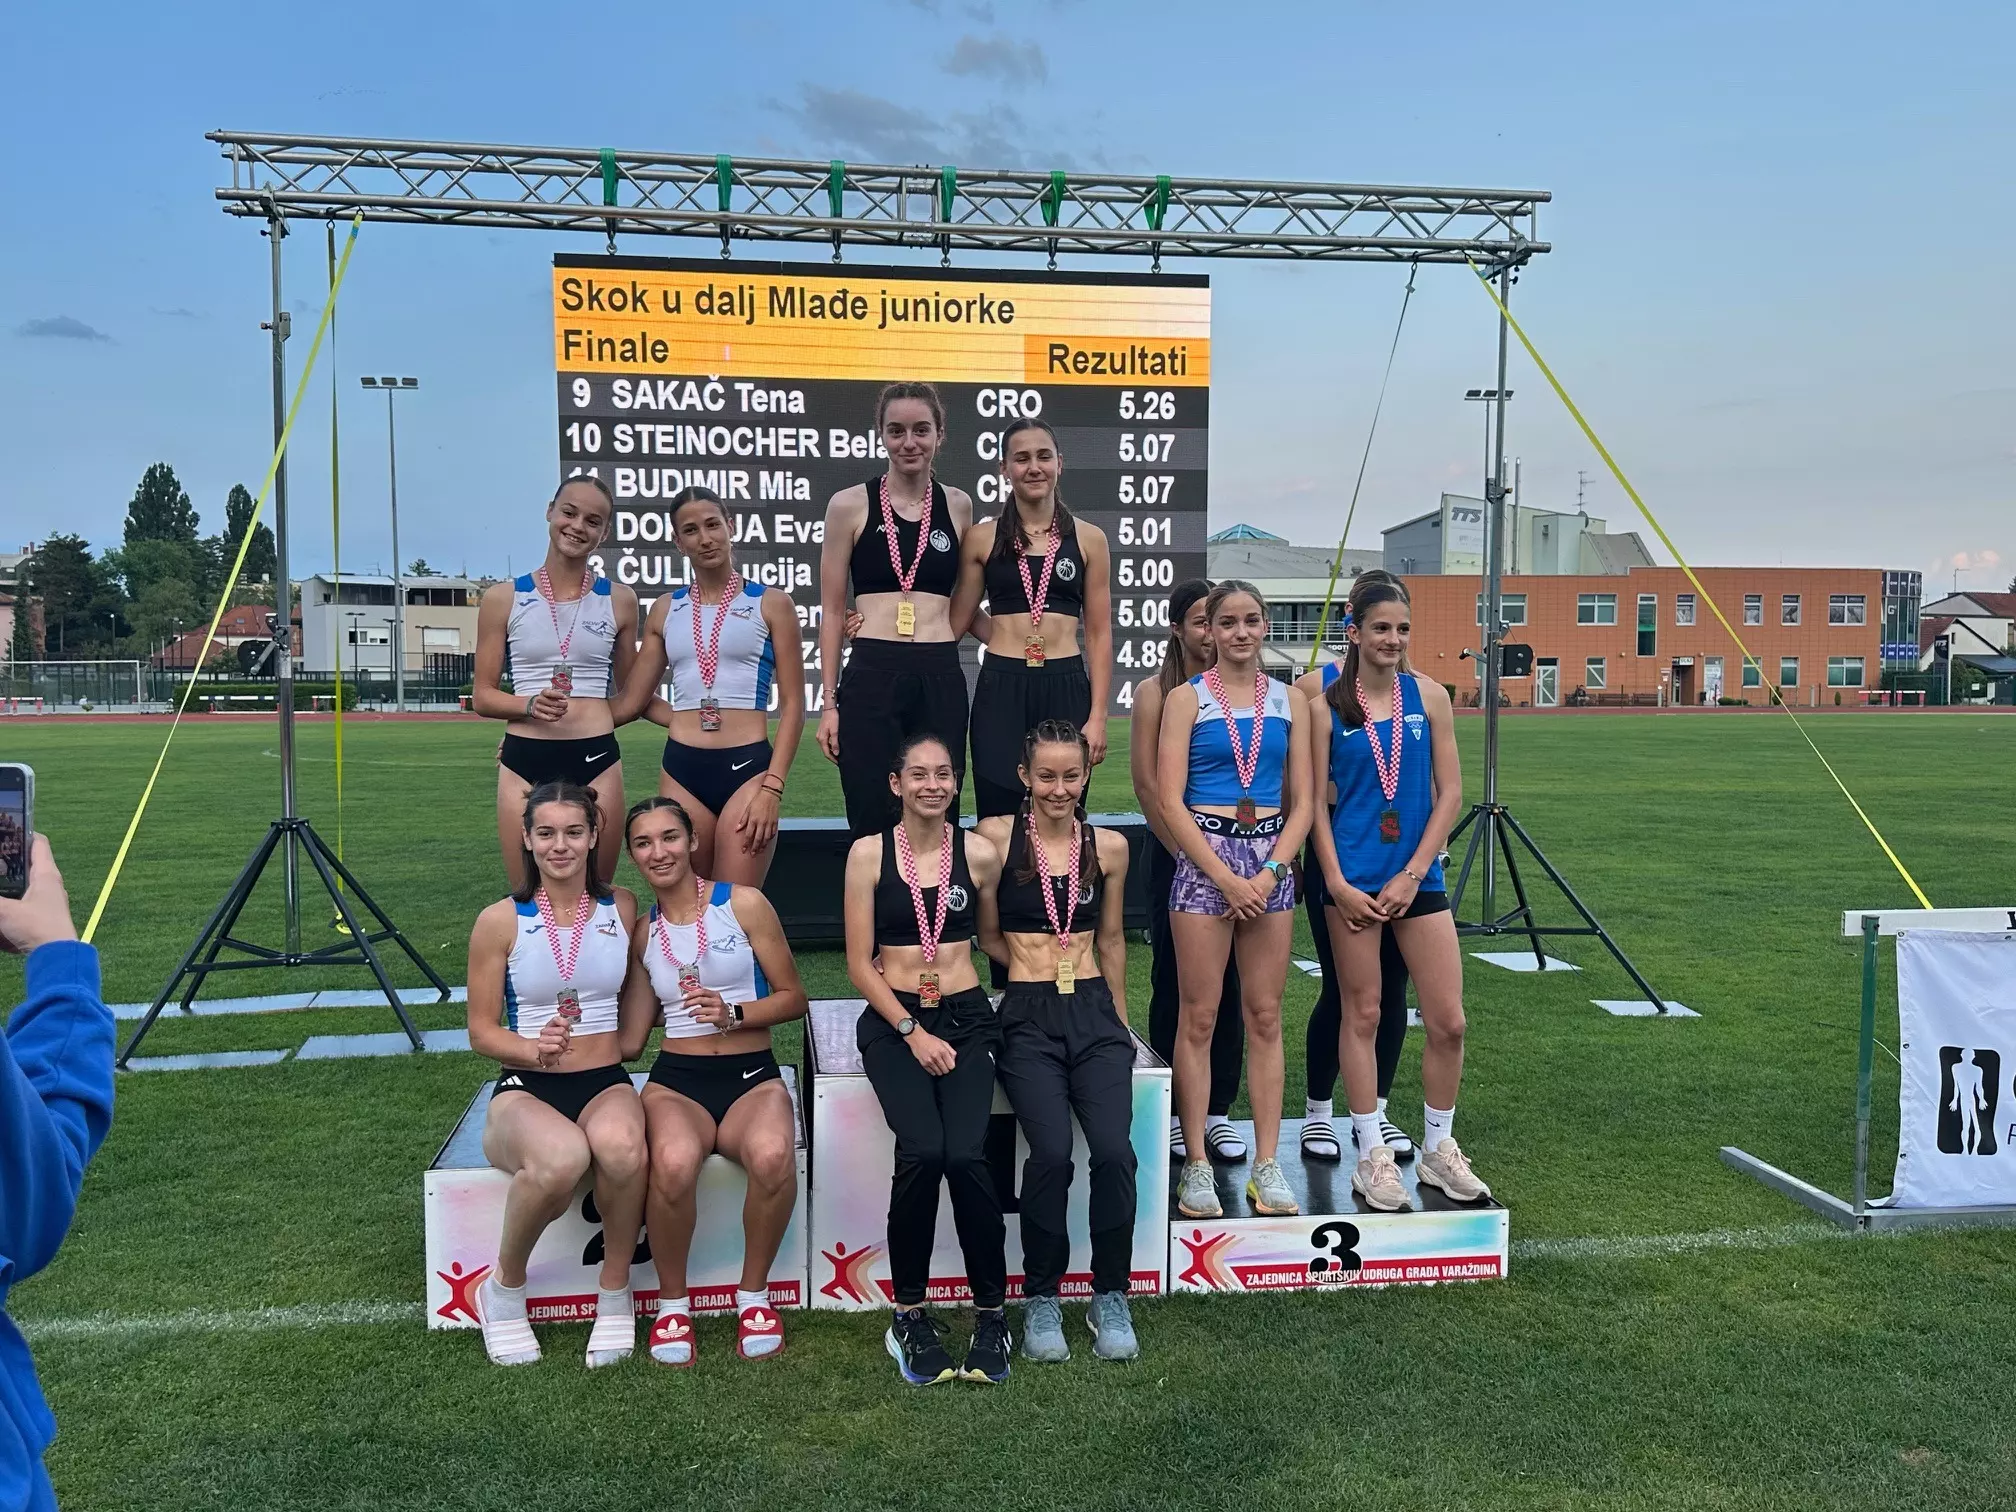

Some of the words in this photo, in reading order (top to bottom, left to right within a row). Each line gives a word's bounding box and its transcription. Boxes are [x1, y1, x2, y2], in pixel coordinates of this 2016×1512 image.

[561, 277, 650, 313] Skok
[663, 289, 682, 315] u
[695, 283, 755, 326] dalj
[768, 285, 868, 320] Mlađe
[877, 289, 1015, 330] juniorke
[563, 329, 670, 363] Finale
[1048, 343, 1187, 376] Rezultati
[572, 377, 592, 408] 9
[611, 374, 726, 412] SAKAČ
[734, 382, 806, 414] Tena
[976, 388, 1043, 418] CRO
[1118, 390, 1176, 420] 5.26
[565, 422, 602, 453] 10
[613, 423, 821, 457] STEINOCHER
[1118, 433, 1175, 462] 5.07
[615, 468, 751, 500] BUDIMIR
[759, 470, 811, 501] Mia
[1118, 475, 1175, 504] 5.07
[1118, 517, 1172, 546] 5.01
[1451, 506, 1483, 523] TTS
[617, 548, 697, 585] ČULI
[742, 557, 813, 593] ucija
[1117, 559, 1174, 587] 5.00
[1117, 599, 1171, 627] 5.00
[1310, 1220, 1362, 1283] 3
[1246, 1272, 1303, 1286] ZAJEDNICA
[1305, 1268, 1360, 1283] SPORTSKIH
[1363, 1266, 1404, 1281] UDRUGA
[1405, 1265, 1440, 1279] GRADA
[1442, 1262, 1497, 1277] VARAŽDINA
[694, 1294, 732, 1308] GRADA
